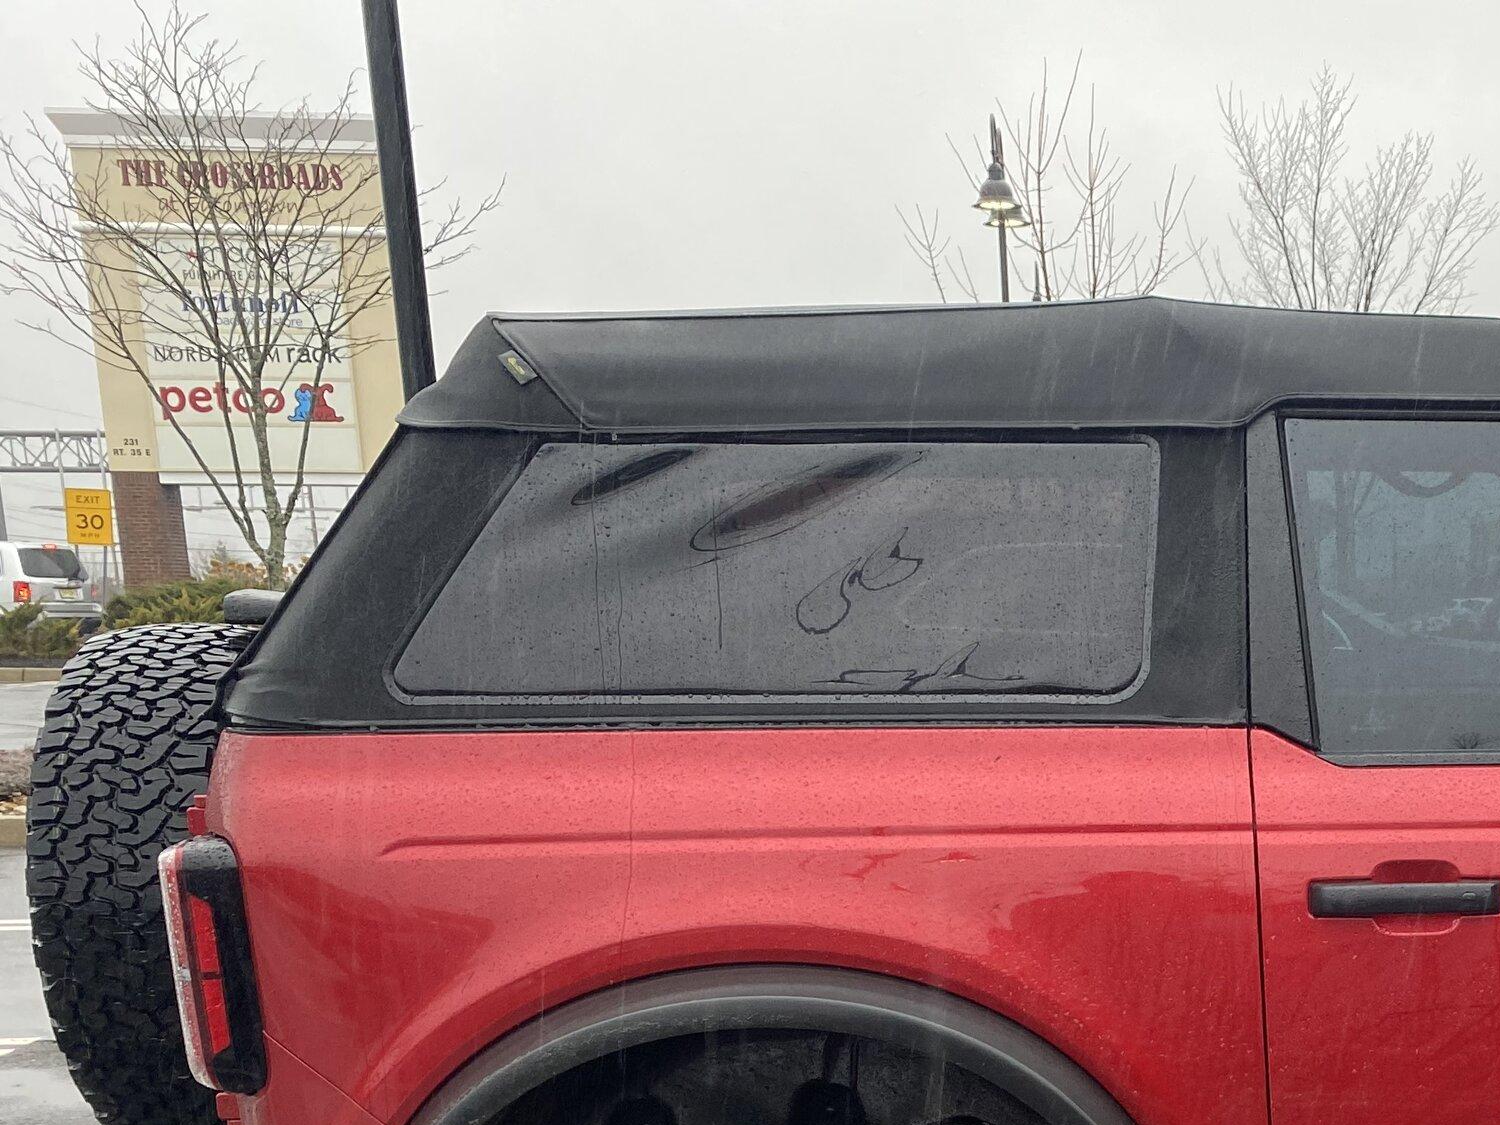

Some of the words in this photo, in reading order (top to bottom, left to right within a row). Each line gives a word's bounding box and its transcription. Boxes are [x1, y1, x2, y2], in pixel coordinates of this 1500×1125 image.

[117, 159, 168, 186] THE
[177, 160, 344, 191] CROSSROADS
[159, 382, 285, 420] petco
[123, 438, 139, 446] 231
[130, 448, 142, 456] 35
[145, 448, 151, 457] E
[75, 495, 100, 504] EXIT
[76, 513, 104, 530] 30
